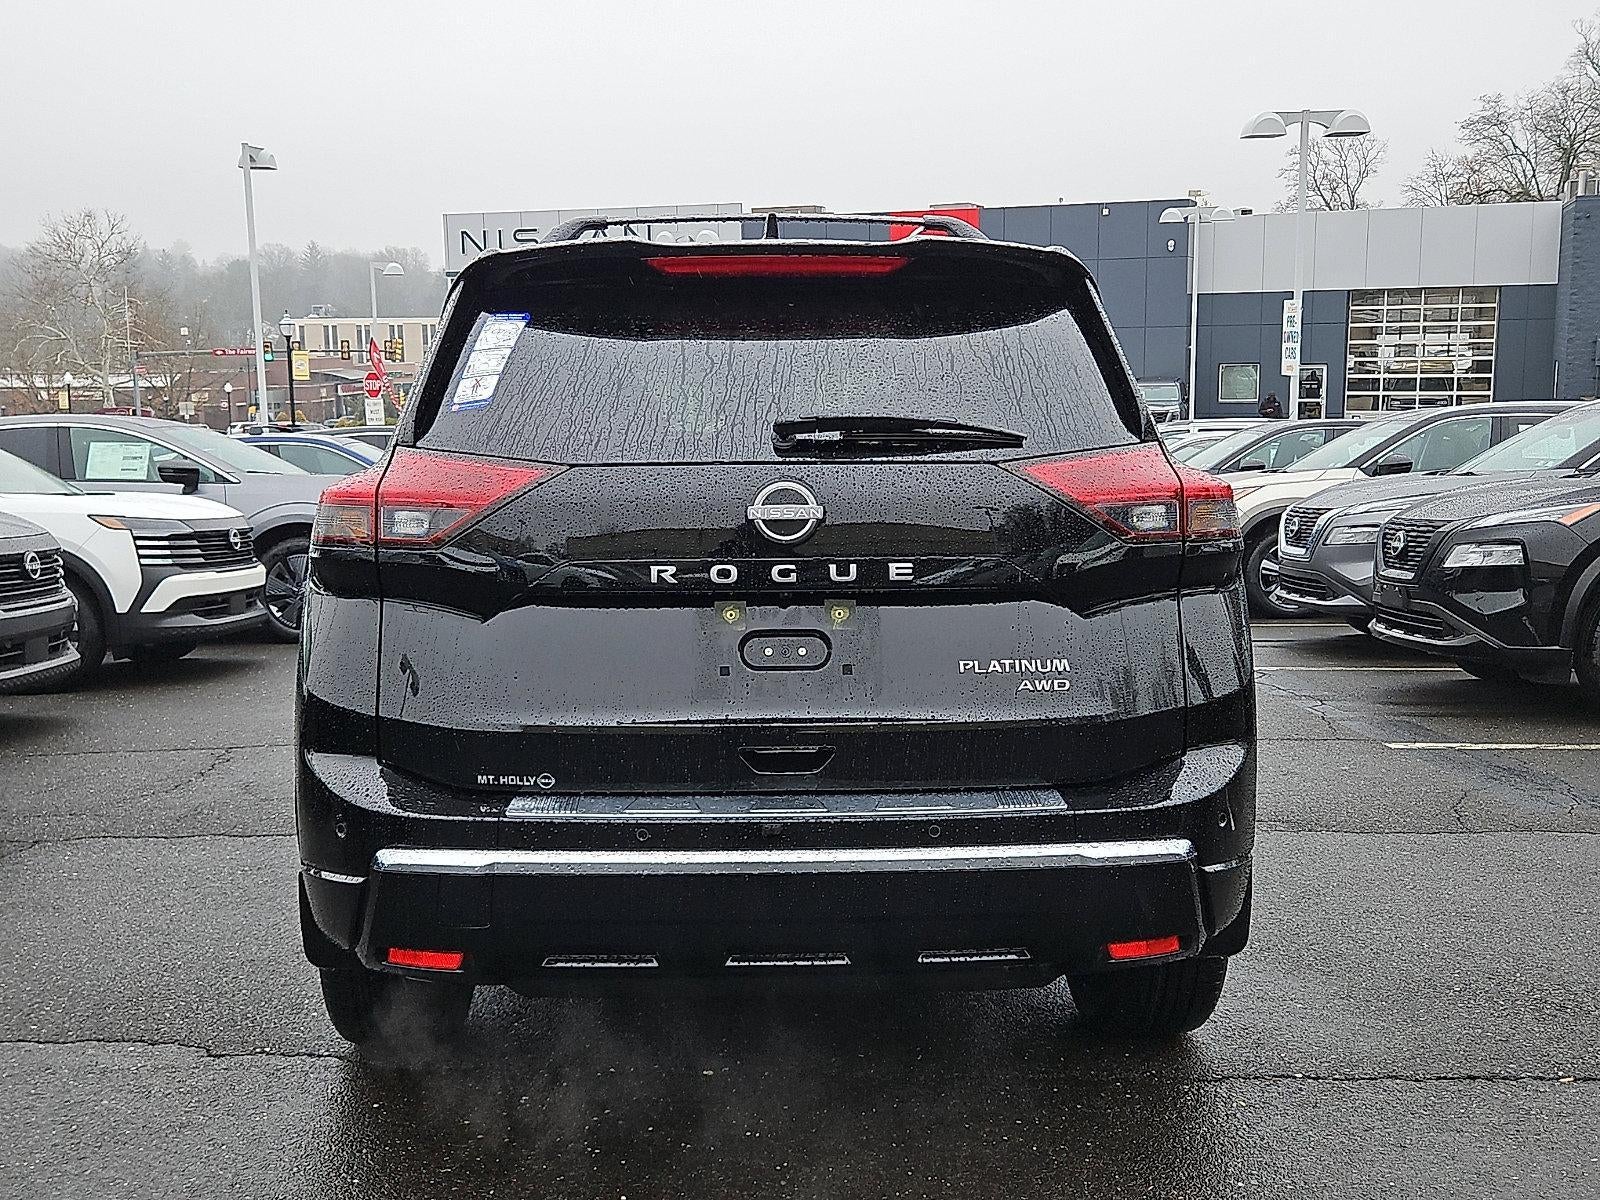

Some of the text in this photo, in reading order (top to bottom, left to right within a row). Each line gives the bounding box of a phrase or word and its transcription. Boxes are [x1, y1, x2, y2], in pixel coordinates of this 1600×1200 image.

[460, 226, 652, 254] NISN
[365, 380, 381, 391] STOP
[749, 507, 821, 519] NISSAN
[650, 562, 915, 584] ROGUE
[959, 659, 1071, 674] PLATINUM
[1017, 679, 1070, 691] AWD
[477, 775, 498, 785] MT.
[500, 775, 536, 785] HOLLY
